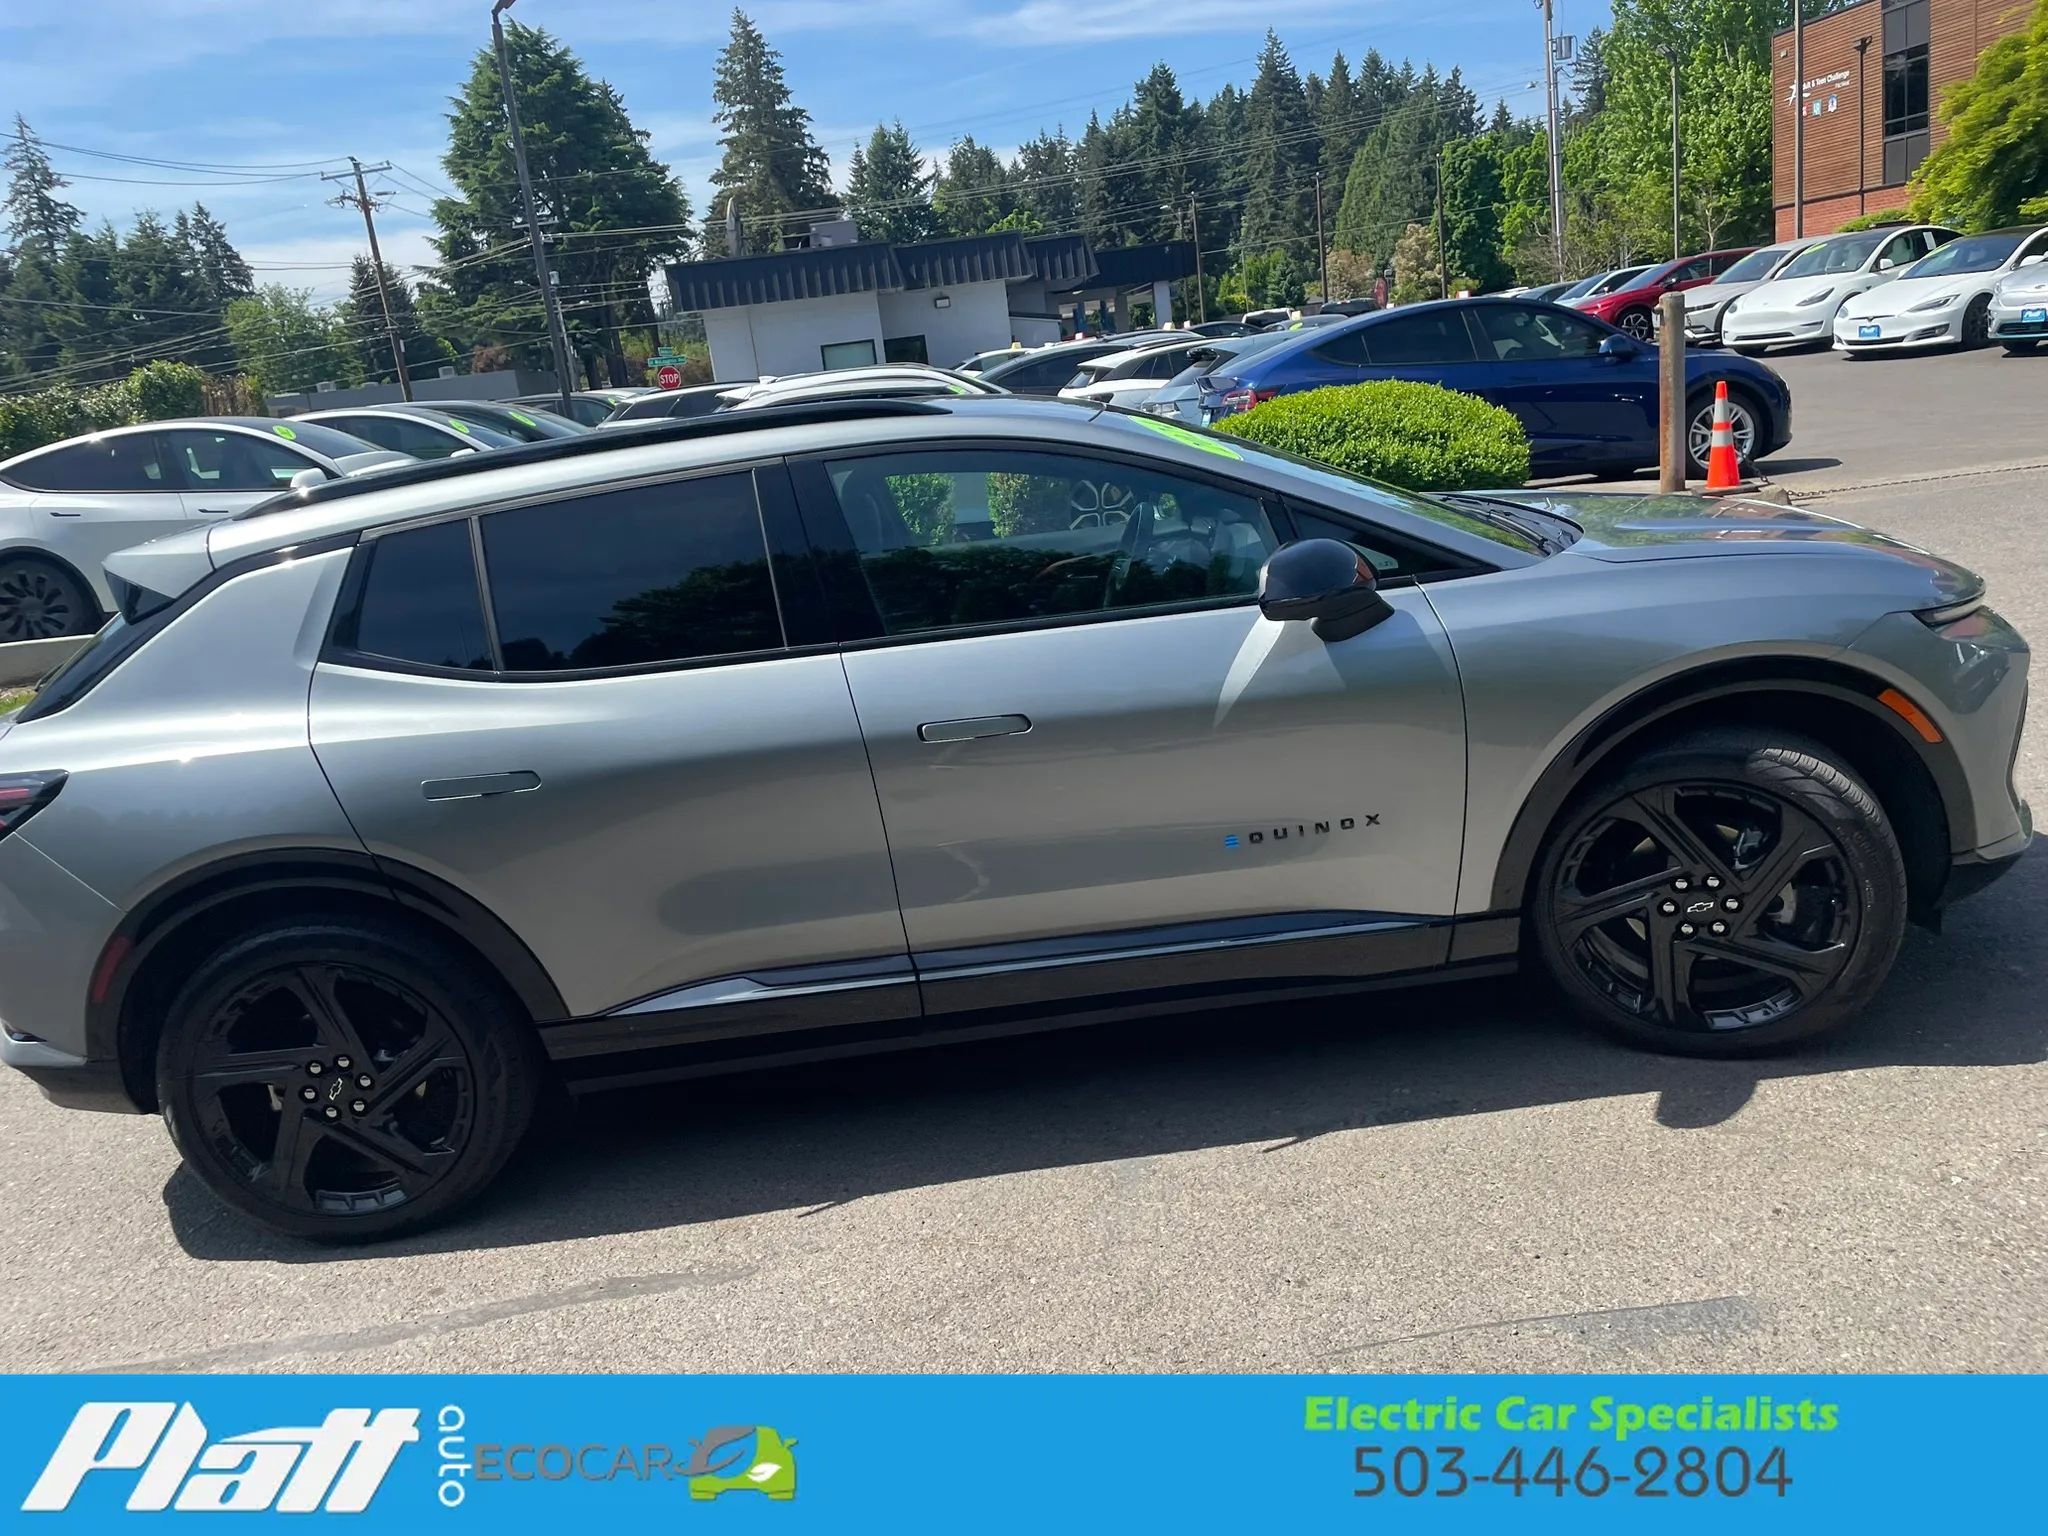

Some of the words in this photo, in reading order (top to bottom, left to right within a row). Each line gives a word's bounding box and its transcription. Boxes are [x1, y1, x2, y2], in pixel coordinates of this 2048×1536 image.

[1826, 70, 1850, 82] Challenge
[660, 373, 679, 385] STOP
[1225, 813, 1381, 849] EQUINOX
